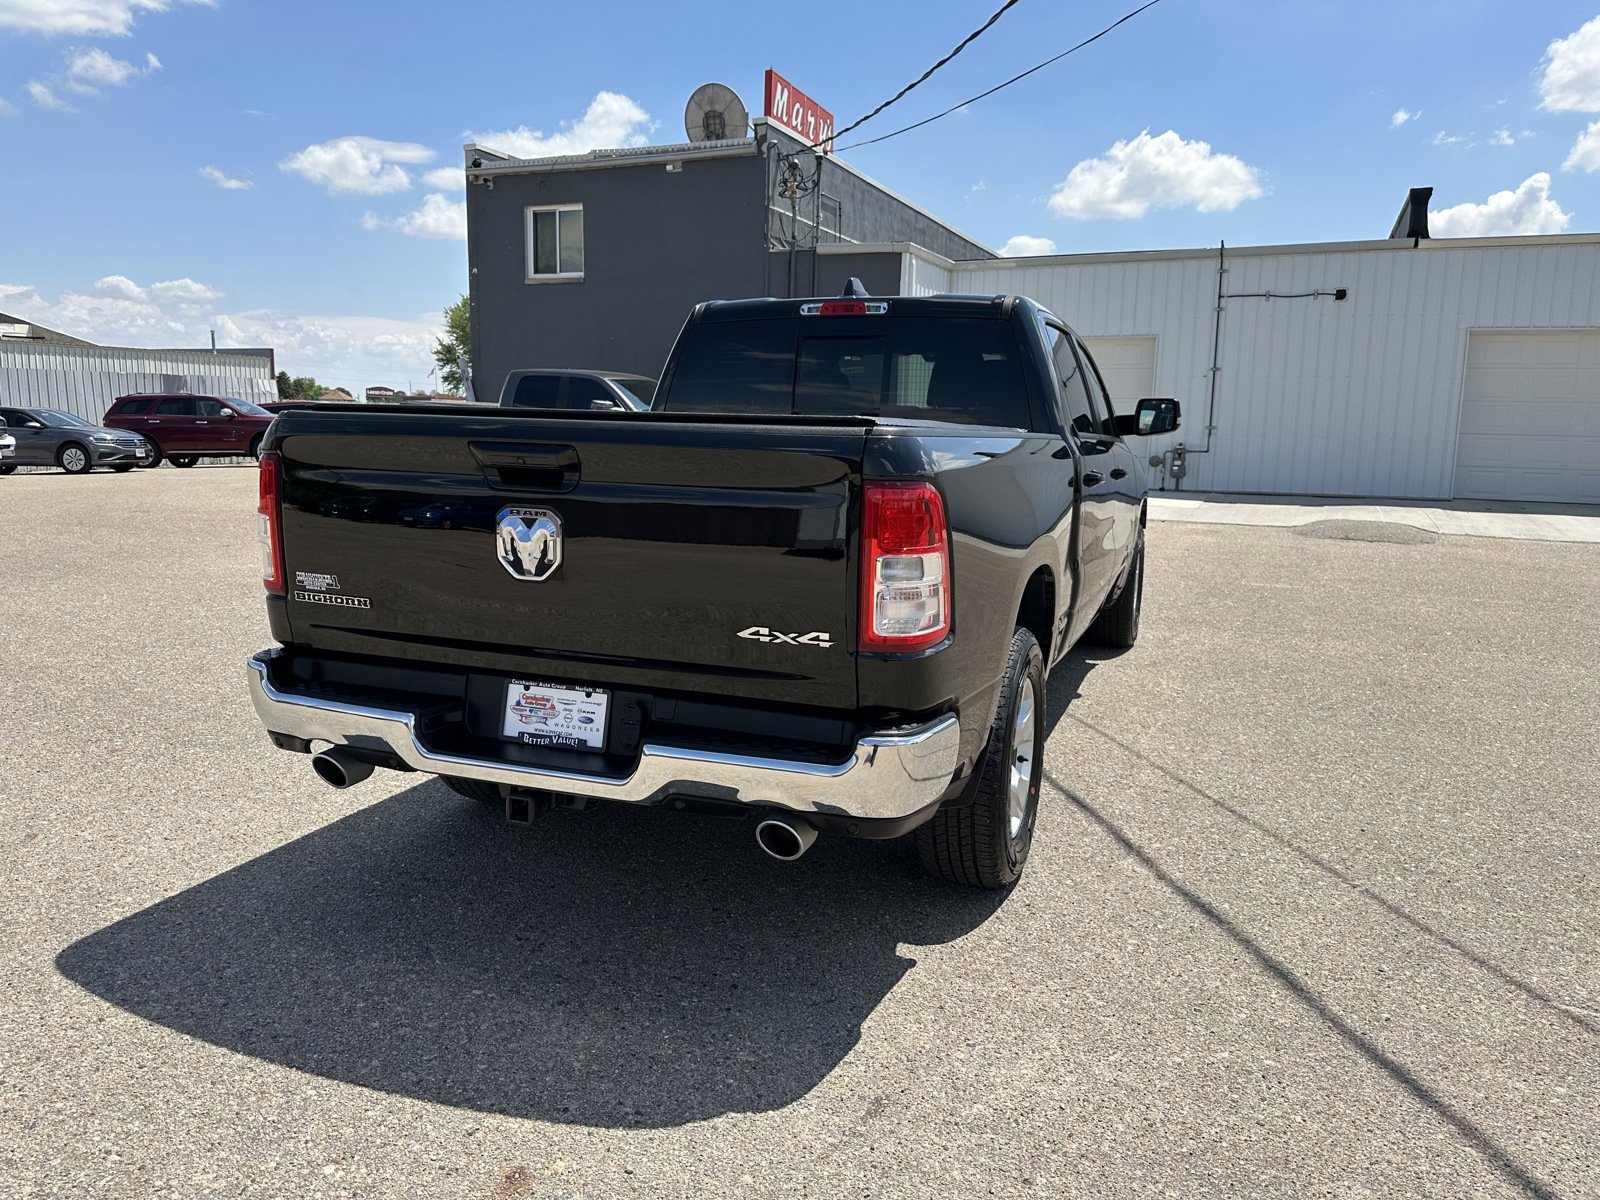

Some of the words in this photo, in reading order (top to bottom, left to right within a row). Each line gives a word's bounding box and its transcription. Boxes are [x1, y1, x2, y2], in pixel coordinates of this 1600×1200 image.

[509, 509, 547, 517] RAM
[294, 590, 370, 608] BIGHORN
[736, 626, 837, 648] 4x4
[511, 678, 538, 686] Cornhusker
[554, 723, 600, 732] WAGONEER
